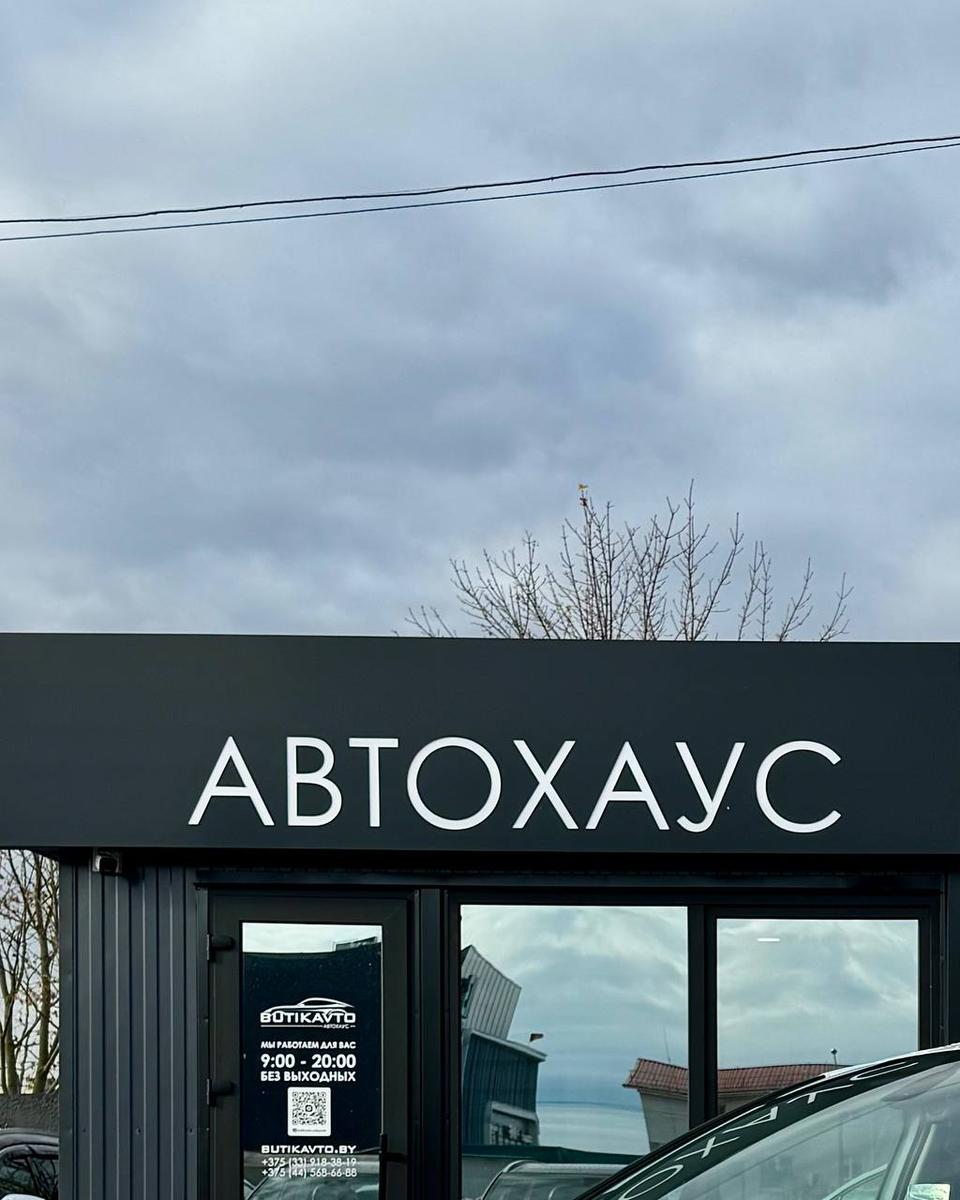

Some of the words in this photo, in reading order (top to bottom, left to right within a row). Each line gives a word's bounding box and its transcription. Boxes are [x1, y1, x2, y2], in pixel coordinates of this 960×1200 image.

[187, 736, 843, 833] АВТОХАУС
[260, 1012, 356, 1023] BUTIKAVTO
[261, 1041, 276, 1049] МЫ
[277, 1041, 319, 1049] РАБОТАЕМ
[320, 1041, 337, 1050] ДЛЯ
[339, 1041, 356, 1049] ВАС
[261, 1054, 296, 1069] 9:00
[311, 1054, 357, 1069] 20:00
[260, 1071, 281, 1082] БЕЗ
[283, 1071, 356, 1083] ВЫХОДНЫХ
[261, 1145, 357, 1154] BUTIKAVTO.BY
[262, 1157, 286, 1167] +375
[288, 1157, 307, 1169] (33)
[309, 1157, 357, 1167] 918-38-19
[262, 1168, 286, 1177] +375
[288, 1168, 307, 1179] (44)
[309, 1168, 357, 1177] 568-66-88
